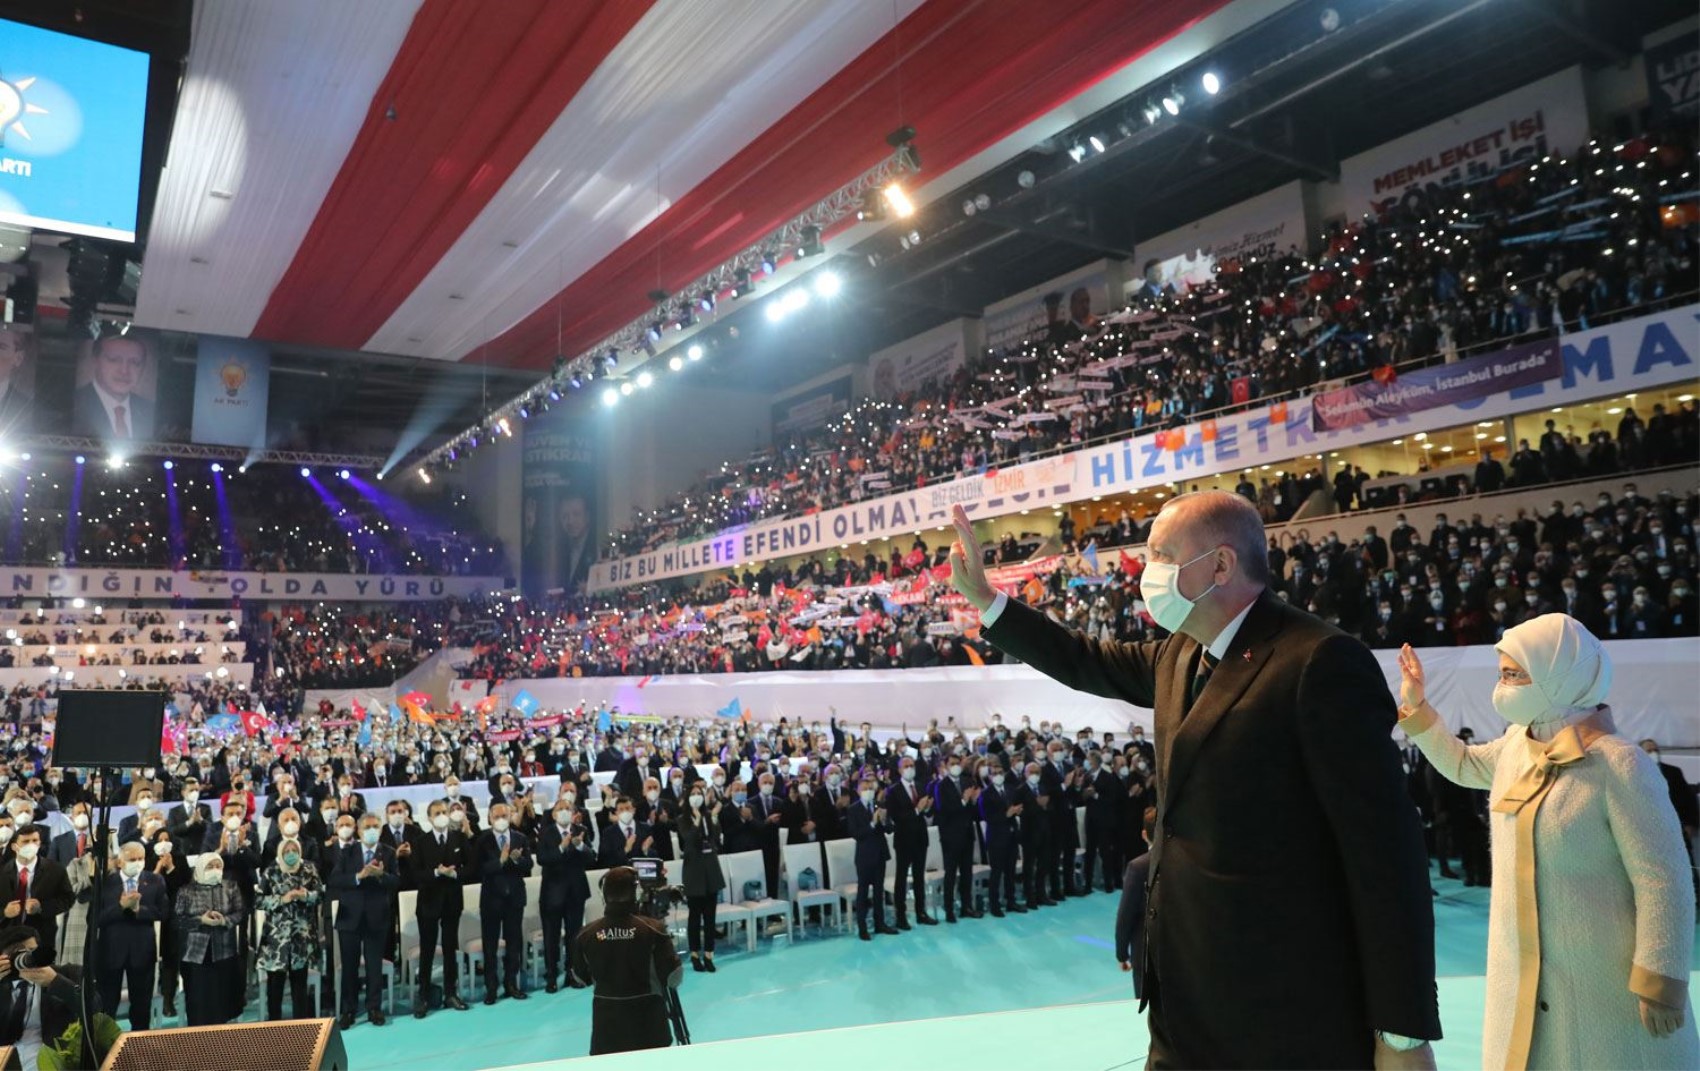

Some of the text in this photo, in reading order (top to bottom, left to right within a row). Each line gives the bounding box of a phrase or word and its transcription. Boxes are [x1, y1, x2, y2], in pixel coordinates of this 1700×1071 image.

[1373, 129, 1507, 194] MEMLEKET
[1436, 366, 1491, 391] İstanbul
[610, 558, 632, 582] BİZ
[638, 559, 657, 577] BU
[663, 539, 735, 572] MİLLETE
[743, 514, 822, 558] EFENDİ
[355, 577, 445, 596] YÜRÜ
[607, 926, 637, 940] Altus
